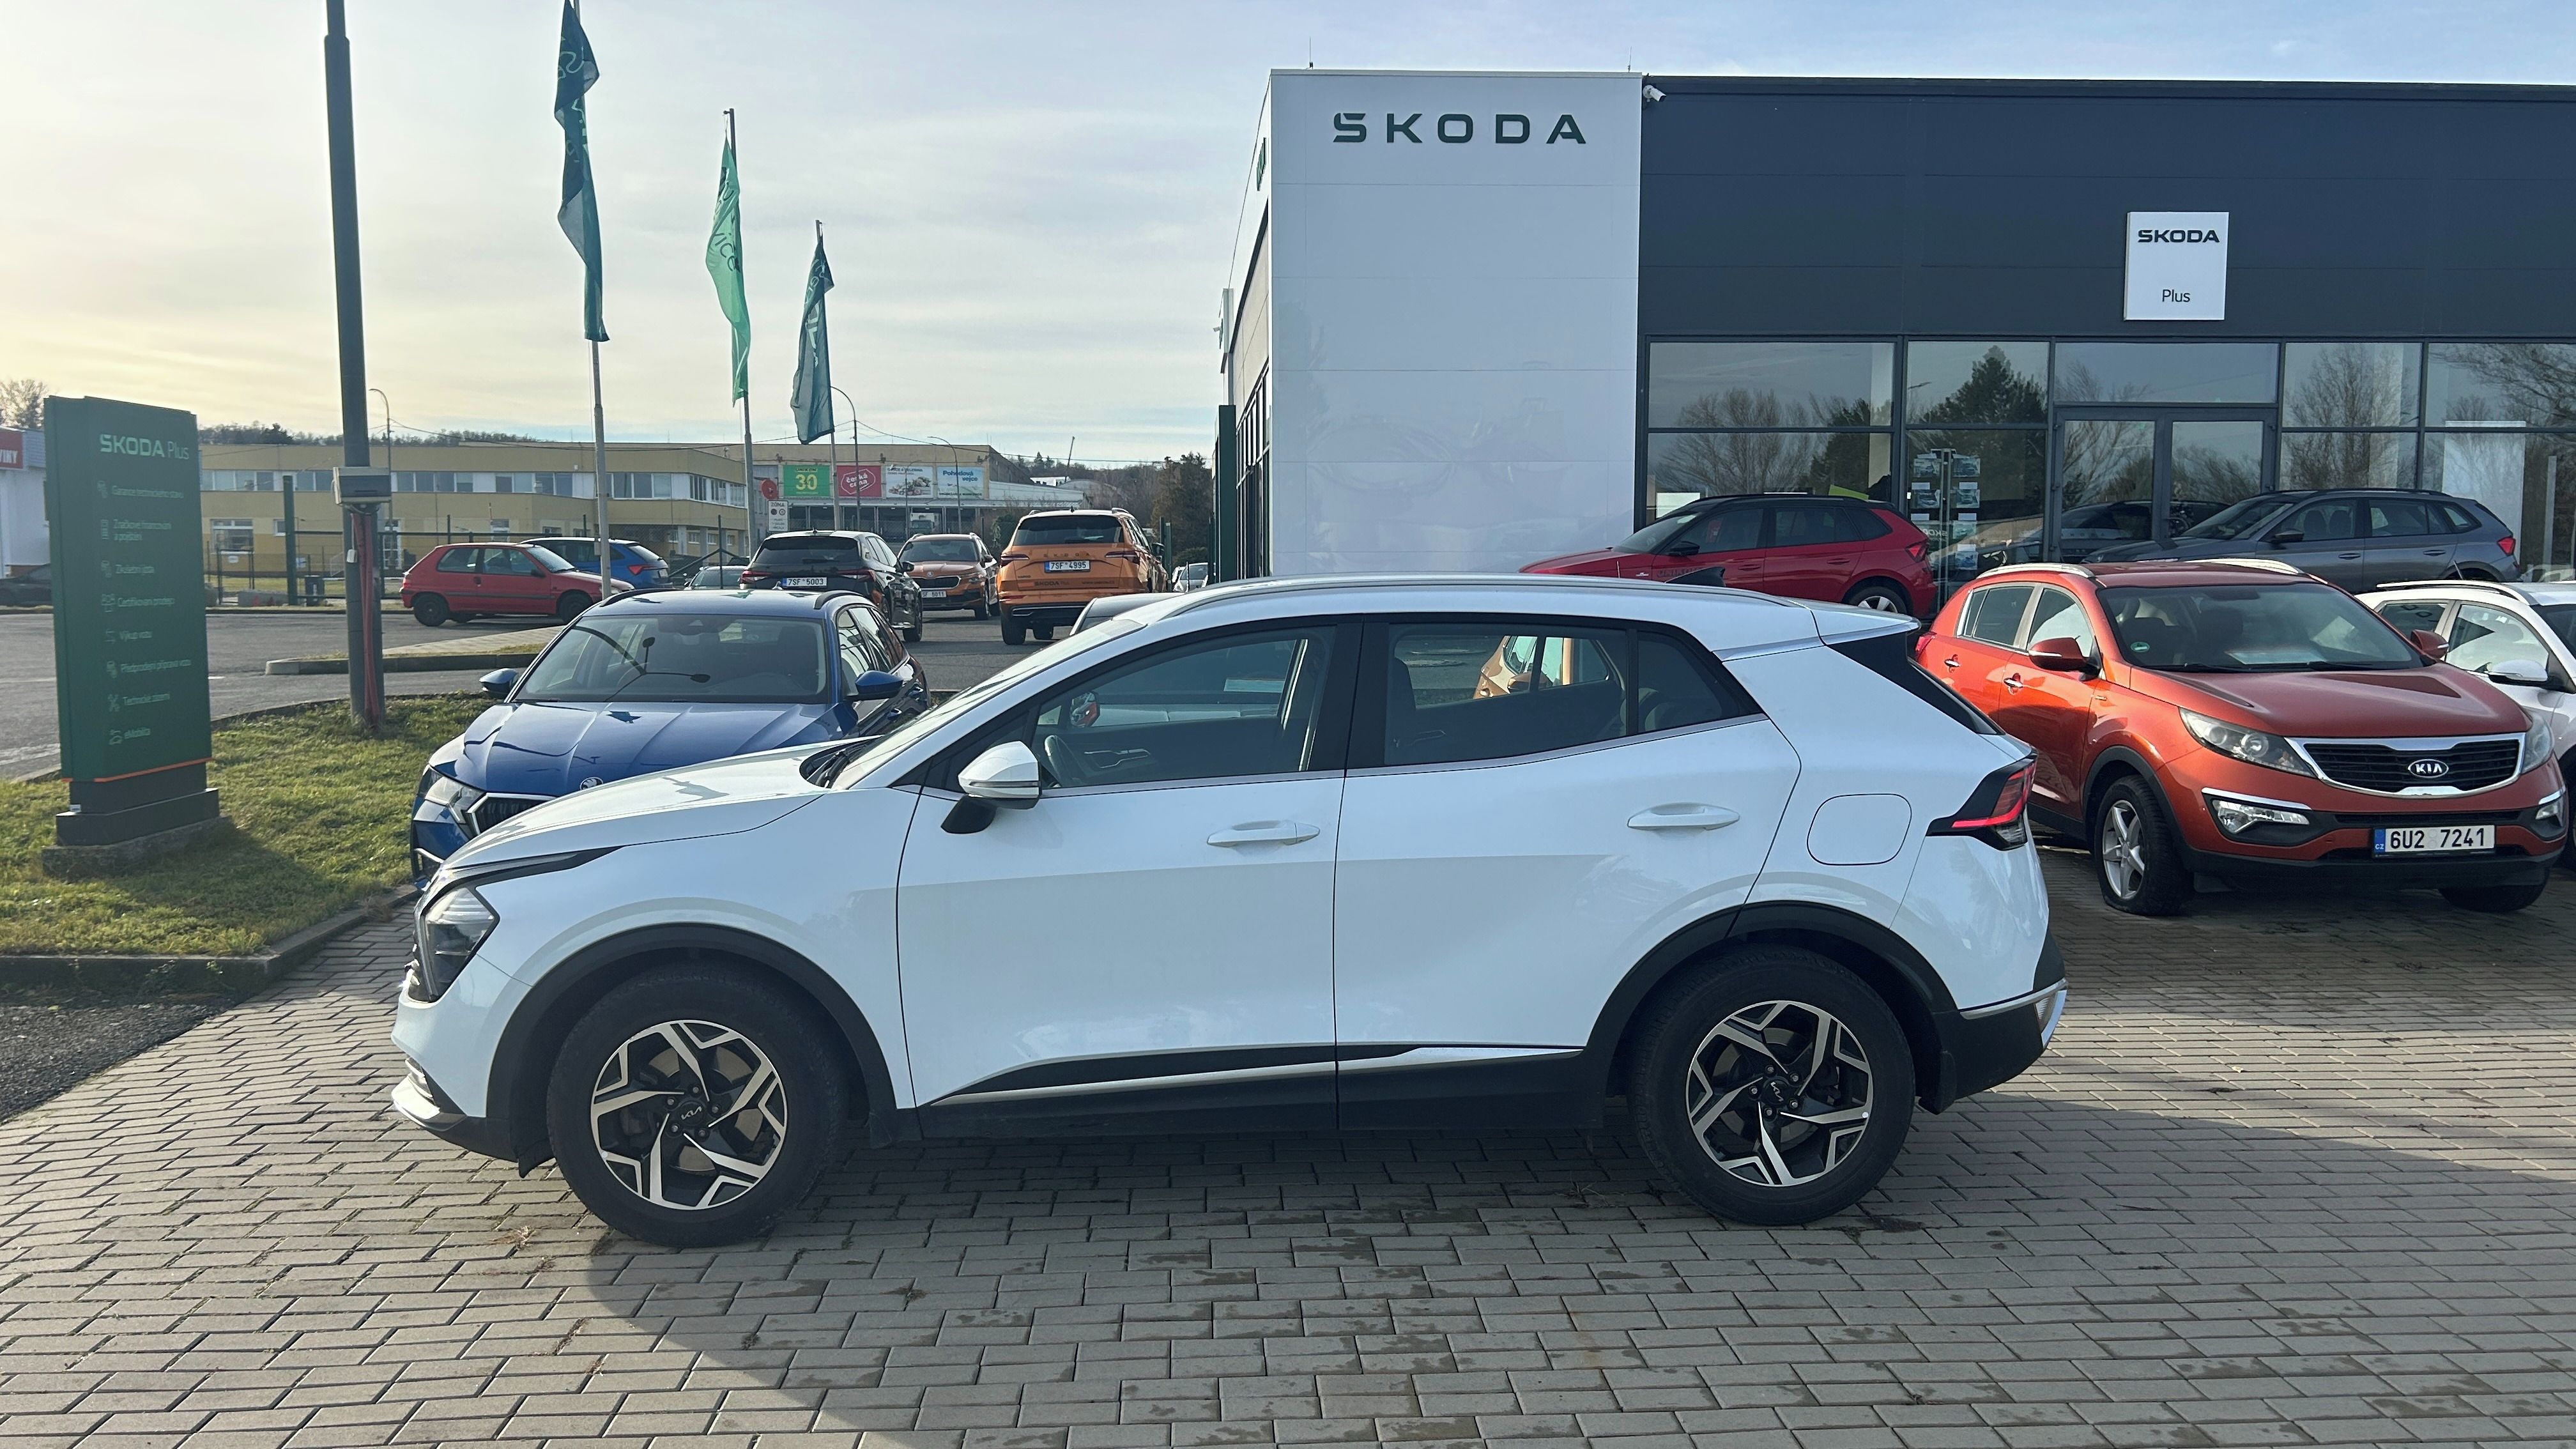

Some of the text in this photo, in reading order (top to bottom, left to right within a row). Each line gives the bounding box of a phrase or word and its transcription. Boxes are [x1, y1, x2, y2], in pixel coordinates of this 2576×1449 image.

[1333, 112, 1586, 144] SKODA
[2138, 230, 2220, 243] SKODA
[2162, 289, 2191, 302] Plus
[100, 434, 190, 460] SKODA Plus
[795, 474, 818, 490] 30
[2415, 763, 2442, 774] KIA
[2391, 831, 2425, 849] 6U2
[2440, 827, 2485, 848] 7241
